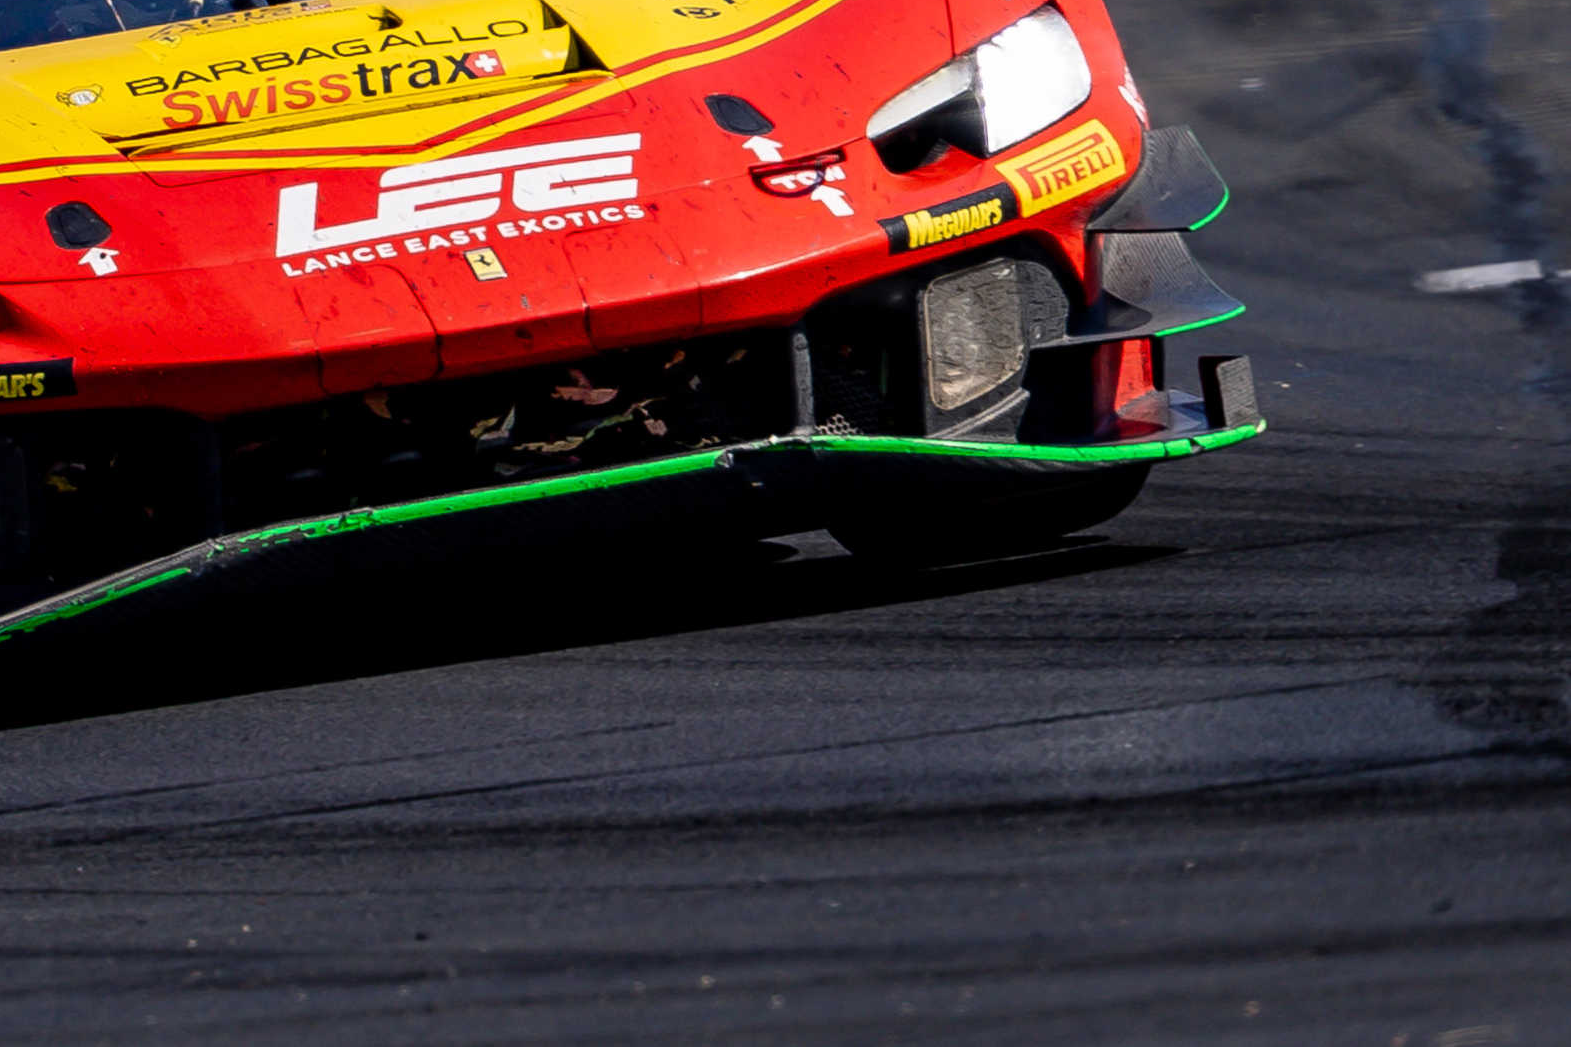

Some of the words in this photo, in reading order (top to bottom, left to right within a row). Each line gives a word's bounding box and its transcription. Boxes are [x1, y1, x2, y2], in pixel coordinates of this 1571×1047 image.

[125, 20, 529, 97] BARBAGALLO
[162, 51, 480, 130] Swisstrax
[275, 132, 642, 258] LEE
[1015, 132, 1116, 201] PIRELLI
[281, 242, 398, 278] LANCE
[403, 226, 488, 255] EAST
[496, 204, 645, 239] EXOTICS
